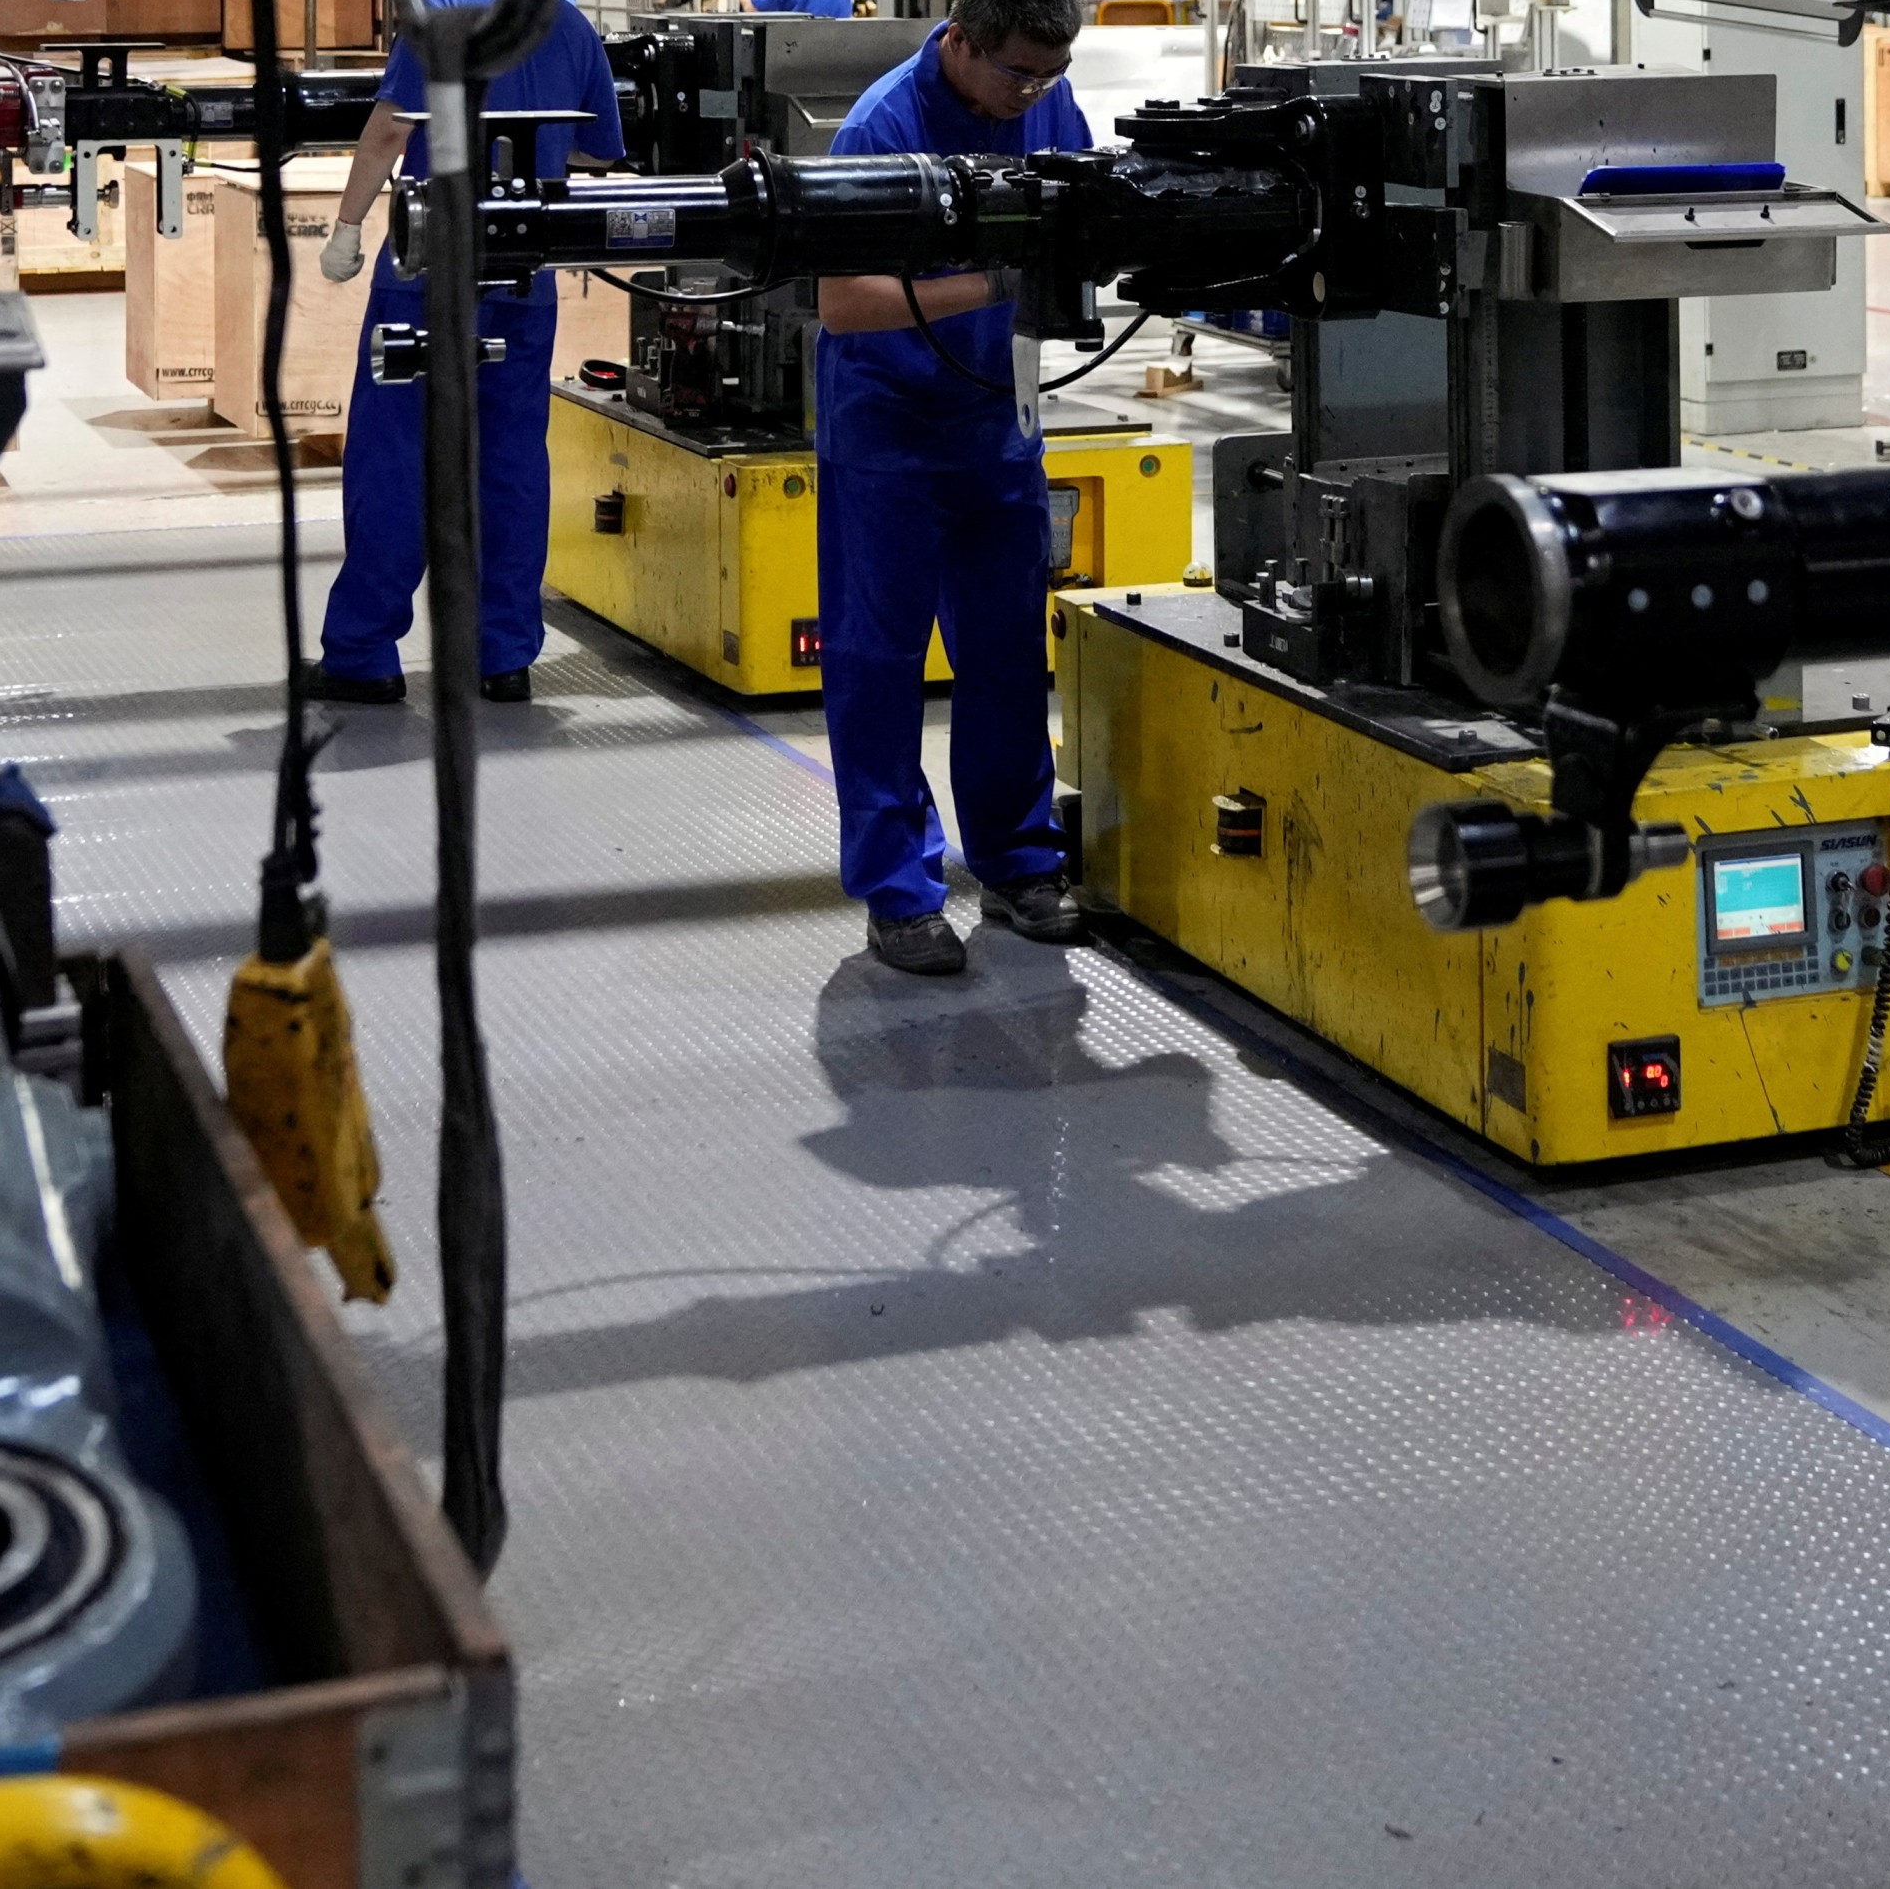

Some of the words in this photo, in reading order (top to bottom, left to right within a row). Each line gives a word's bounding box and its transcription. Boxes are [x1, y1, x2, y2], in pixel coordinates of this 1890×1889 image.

[186, 203, 215, 215] CRR
[161, 367, 215, 380] www.crrcg
[1819, 835, 1878, 851] SIASUN
